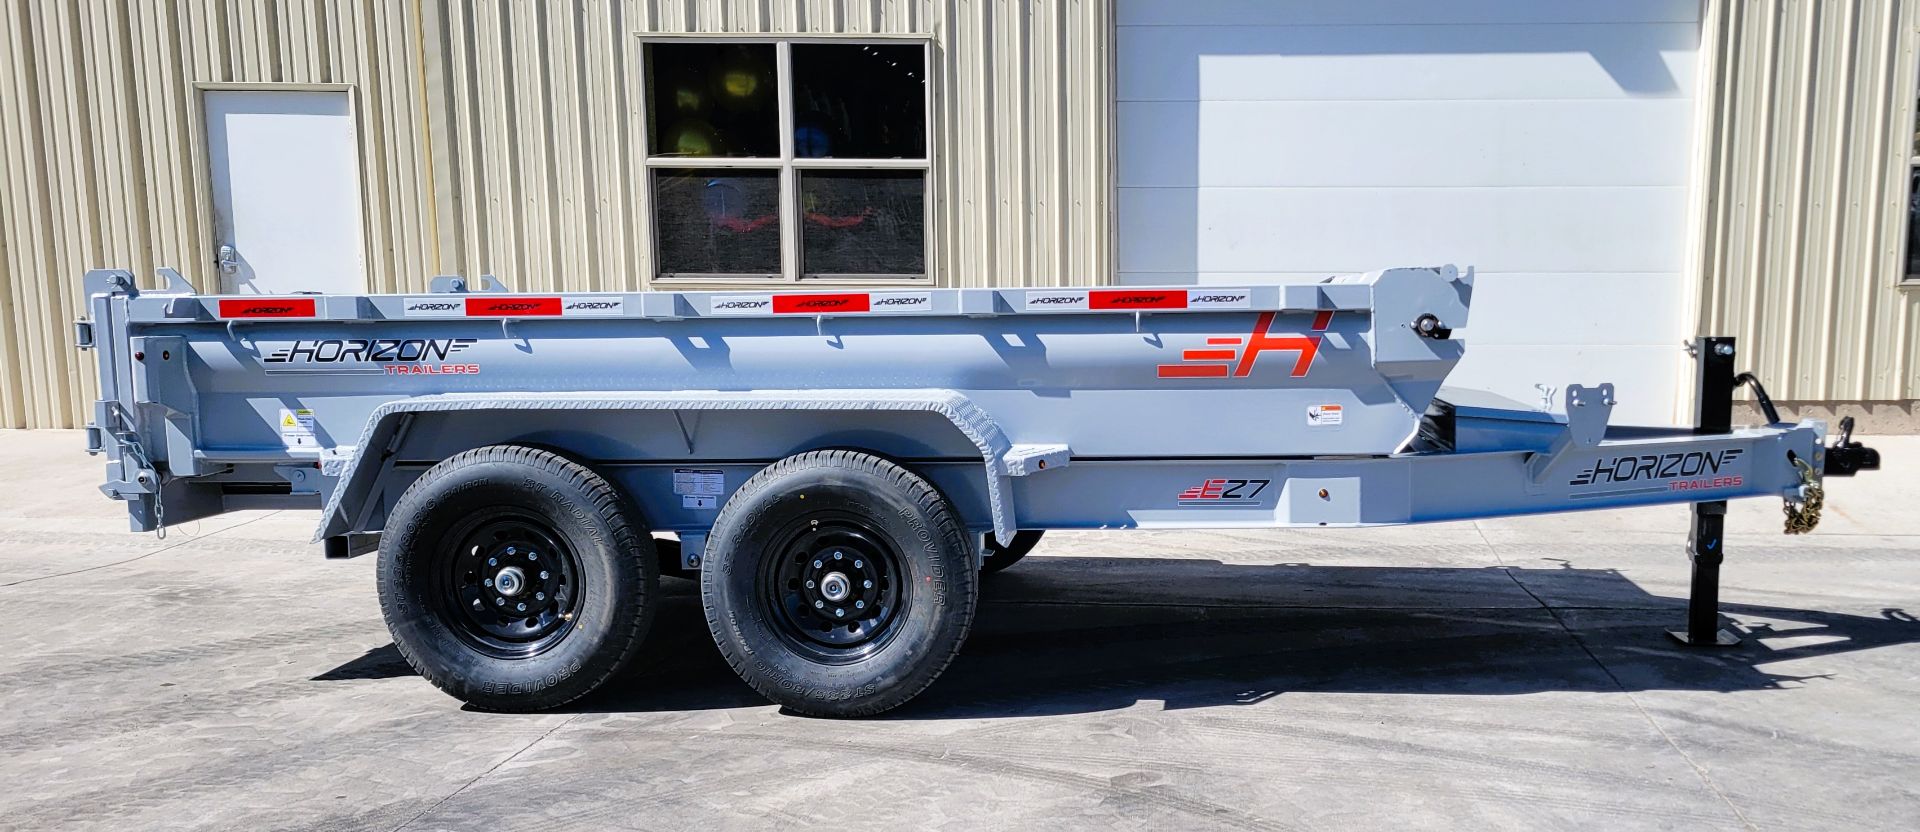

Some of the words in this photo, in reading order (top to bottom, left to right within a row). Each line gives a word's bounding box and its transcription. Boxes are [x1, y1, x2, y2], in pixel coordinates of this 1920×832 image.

[877, 297, 924, 306] HORIZON
[1032, 296, 1082, 305] HORIZON
[1193, 295, 1242, 303] HORIZON
[245, 306, 292, 314] HORIZON
[411, 303, 458, 311] HORIZON
[569, 302, 618, 310] HORIZON
[718, 301, 767, 309] HORIZON
[278, 338, 462, 363] HORIZON
[384, 364, 480, 375] TRAILERS
[1584, 450, 1731, 485] HORIZON
[1196, 479, 1271, 499] E27
[1667, 476, 1743, 491] TRAILERS
[522, 478, 547, 492] ST
[550, 490, 603, 546] RADIAL
[897, 506, 946, 606] PROVIDER
[482, 658, 581, 695] PROVIDER
